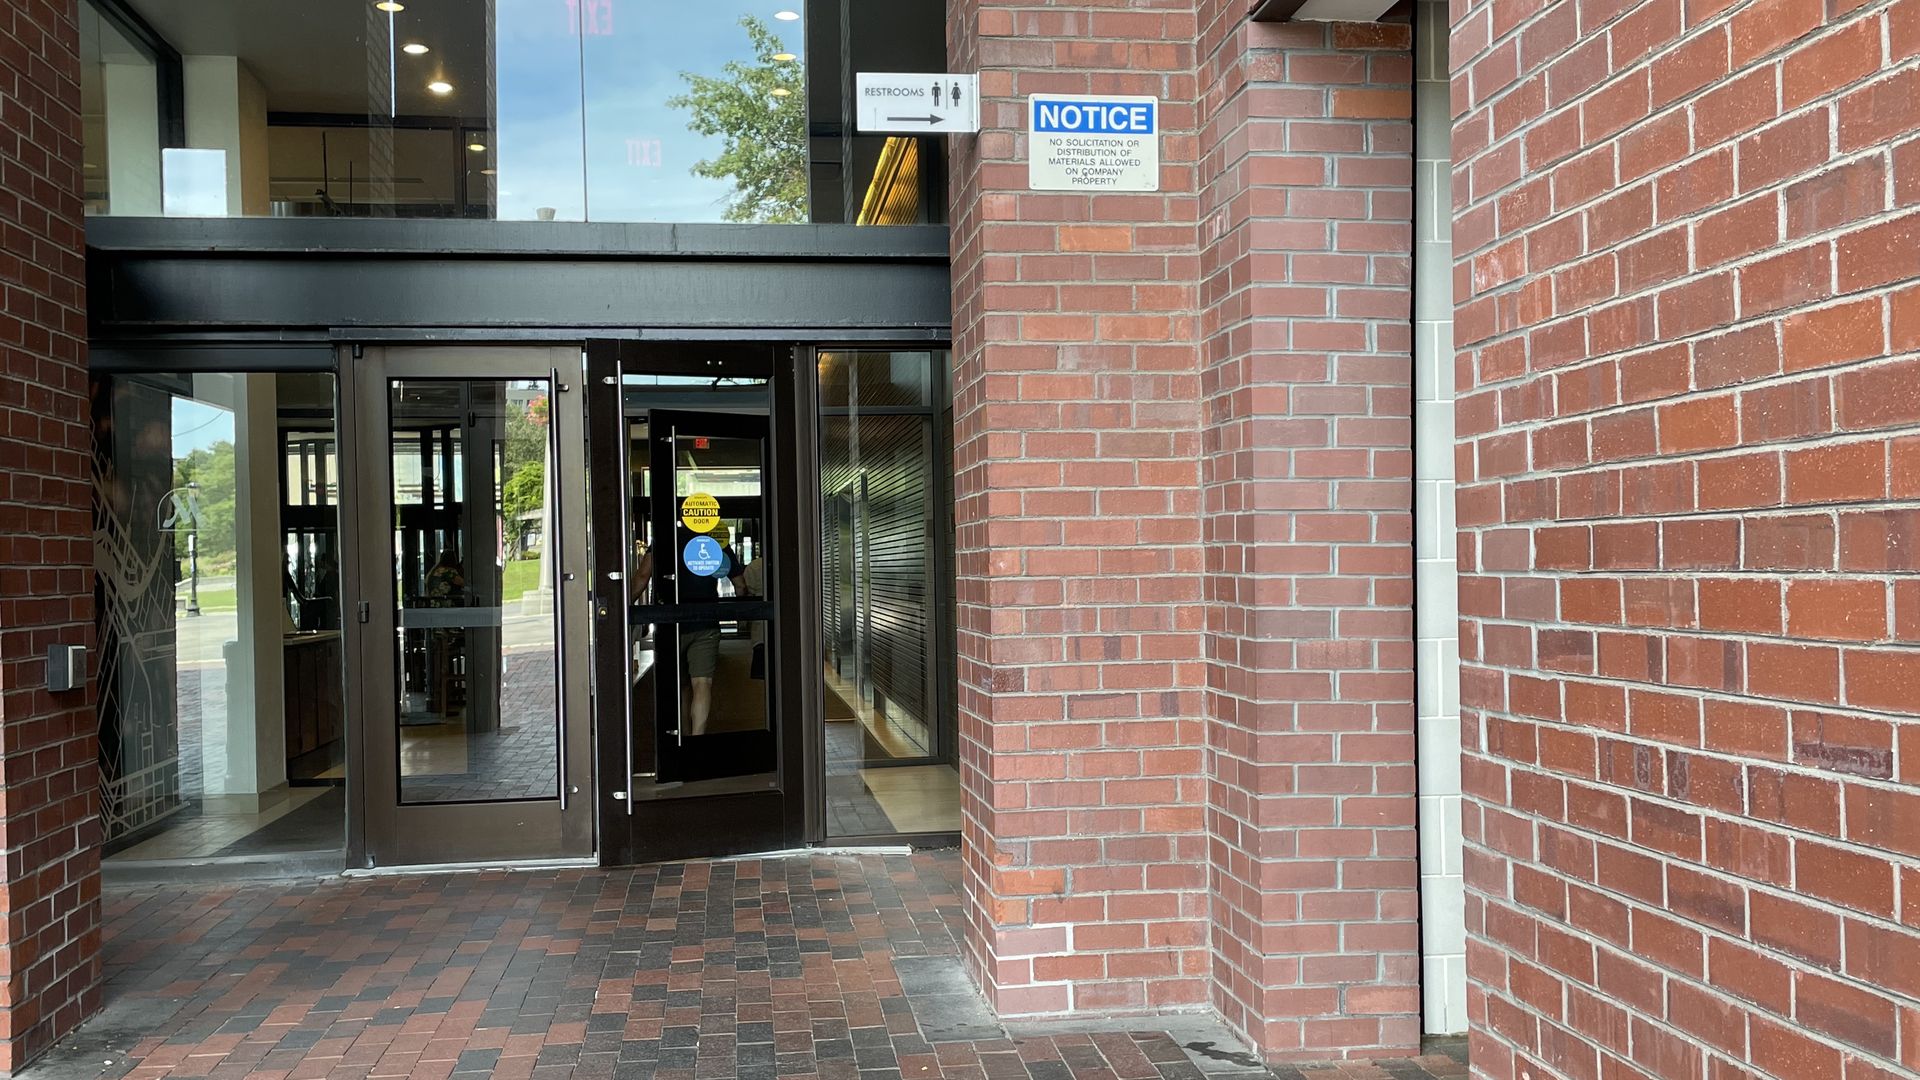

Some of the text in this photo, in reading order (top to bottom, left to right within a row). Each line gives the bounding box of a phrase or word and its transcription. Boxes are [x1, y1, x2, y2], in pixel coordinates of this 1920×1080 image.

[865, 88, 925, 97] RESTROOMS
[1040, 104, 1147, 130] NOTICE
[1049, 138, 1140, 148] NO SOLICITATION OR
[1057, 148, 1132, 157] DISTRIBUTION OF
[1048, 158, 1141, 167] MATERIALS ALLOWED
[1065, 167, 1124, 176] ON COMPANY
[1072, 177, 1118, 185] PROPERTY
[683, 508, 718, 516] CAUTION
